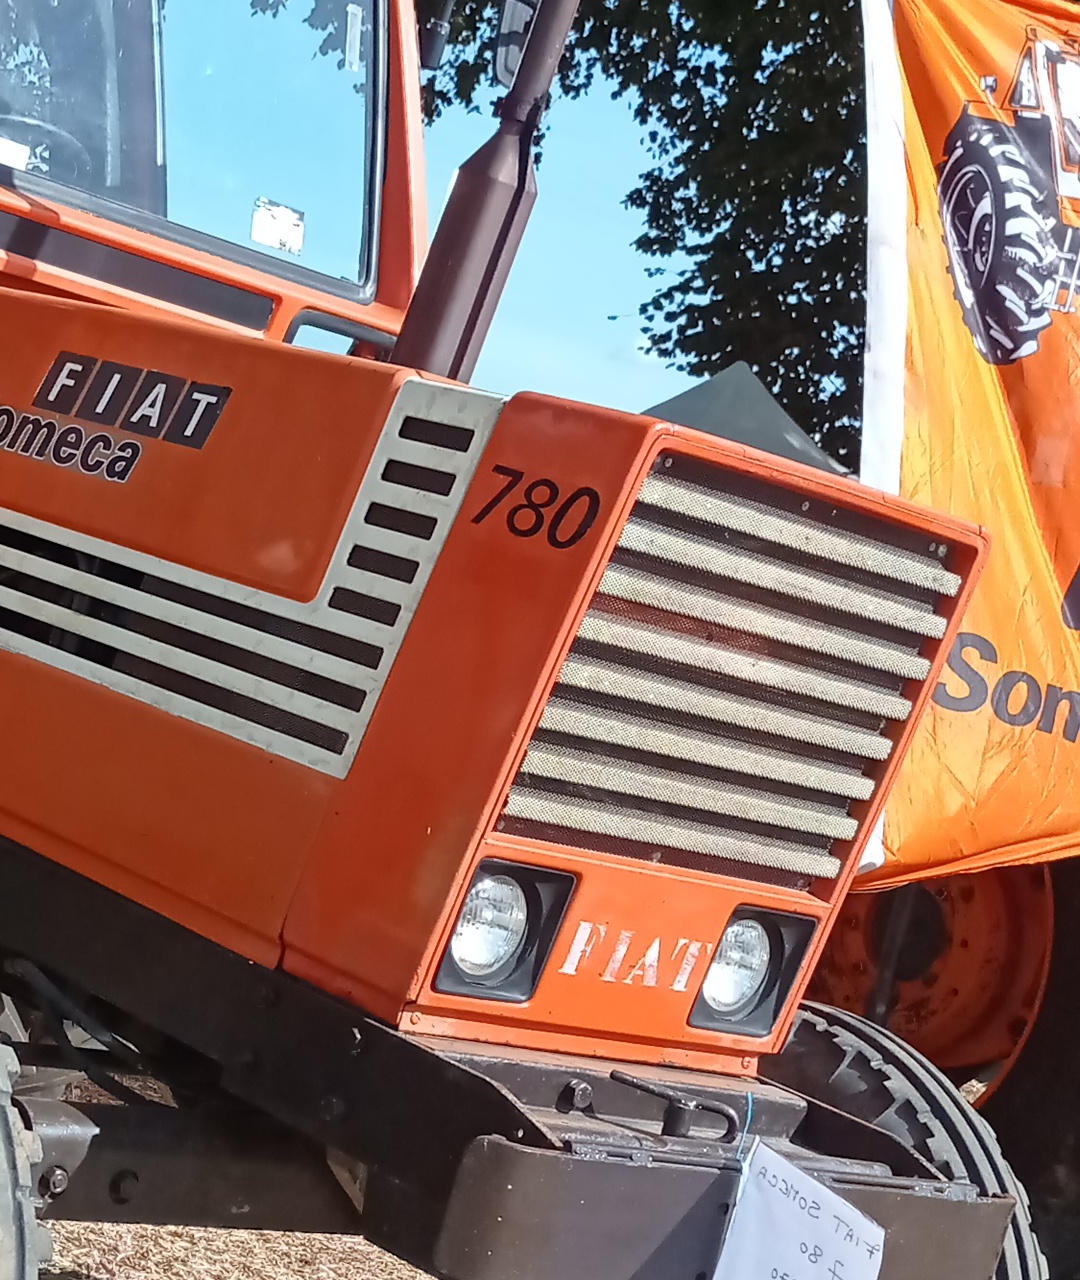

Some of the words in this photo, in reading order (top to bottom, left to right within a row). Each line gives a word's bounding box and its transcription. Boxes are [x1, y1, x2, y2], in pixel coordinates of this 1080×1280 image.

[46, 361, 218, 436] FIAT
[470, 464, 601, 550] 780
[558, 920, 713, 992] FIAT
